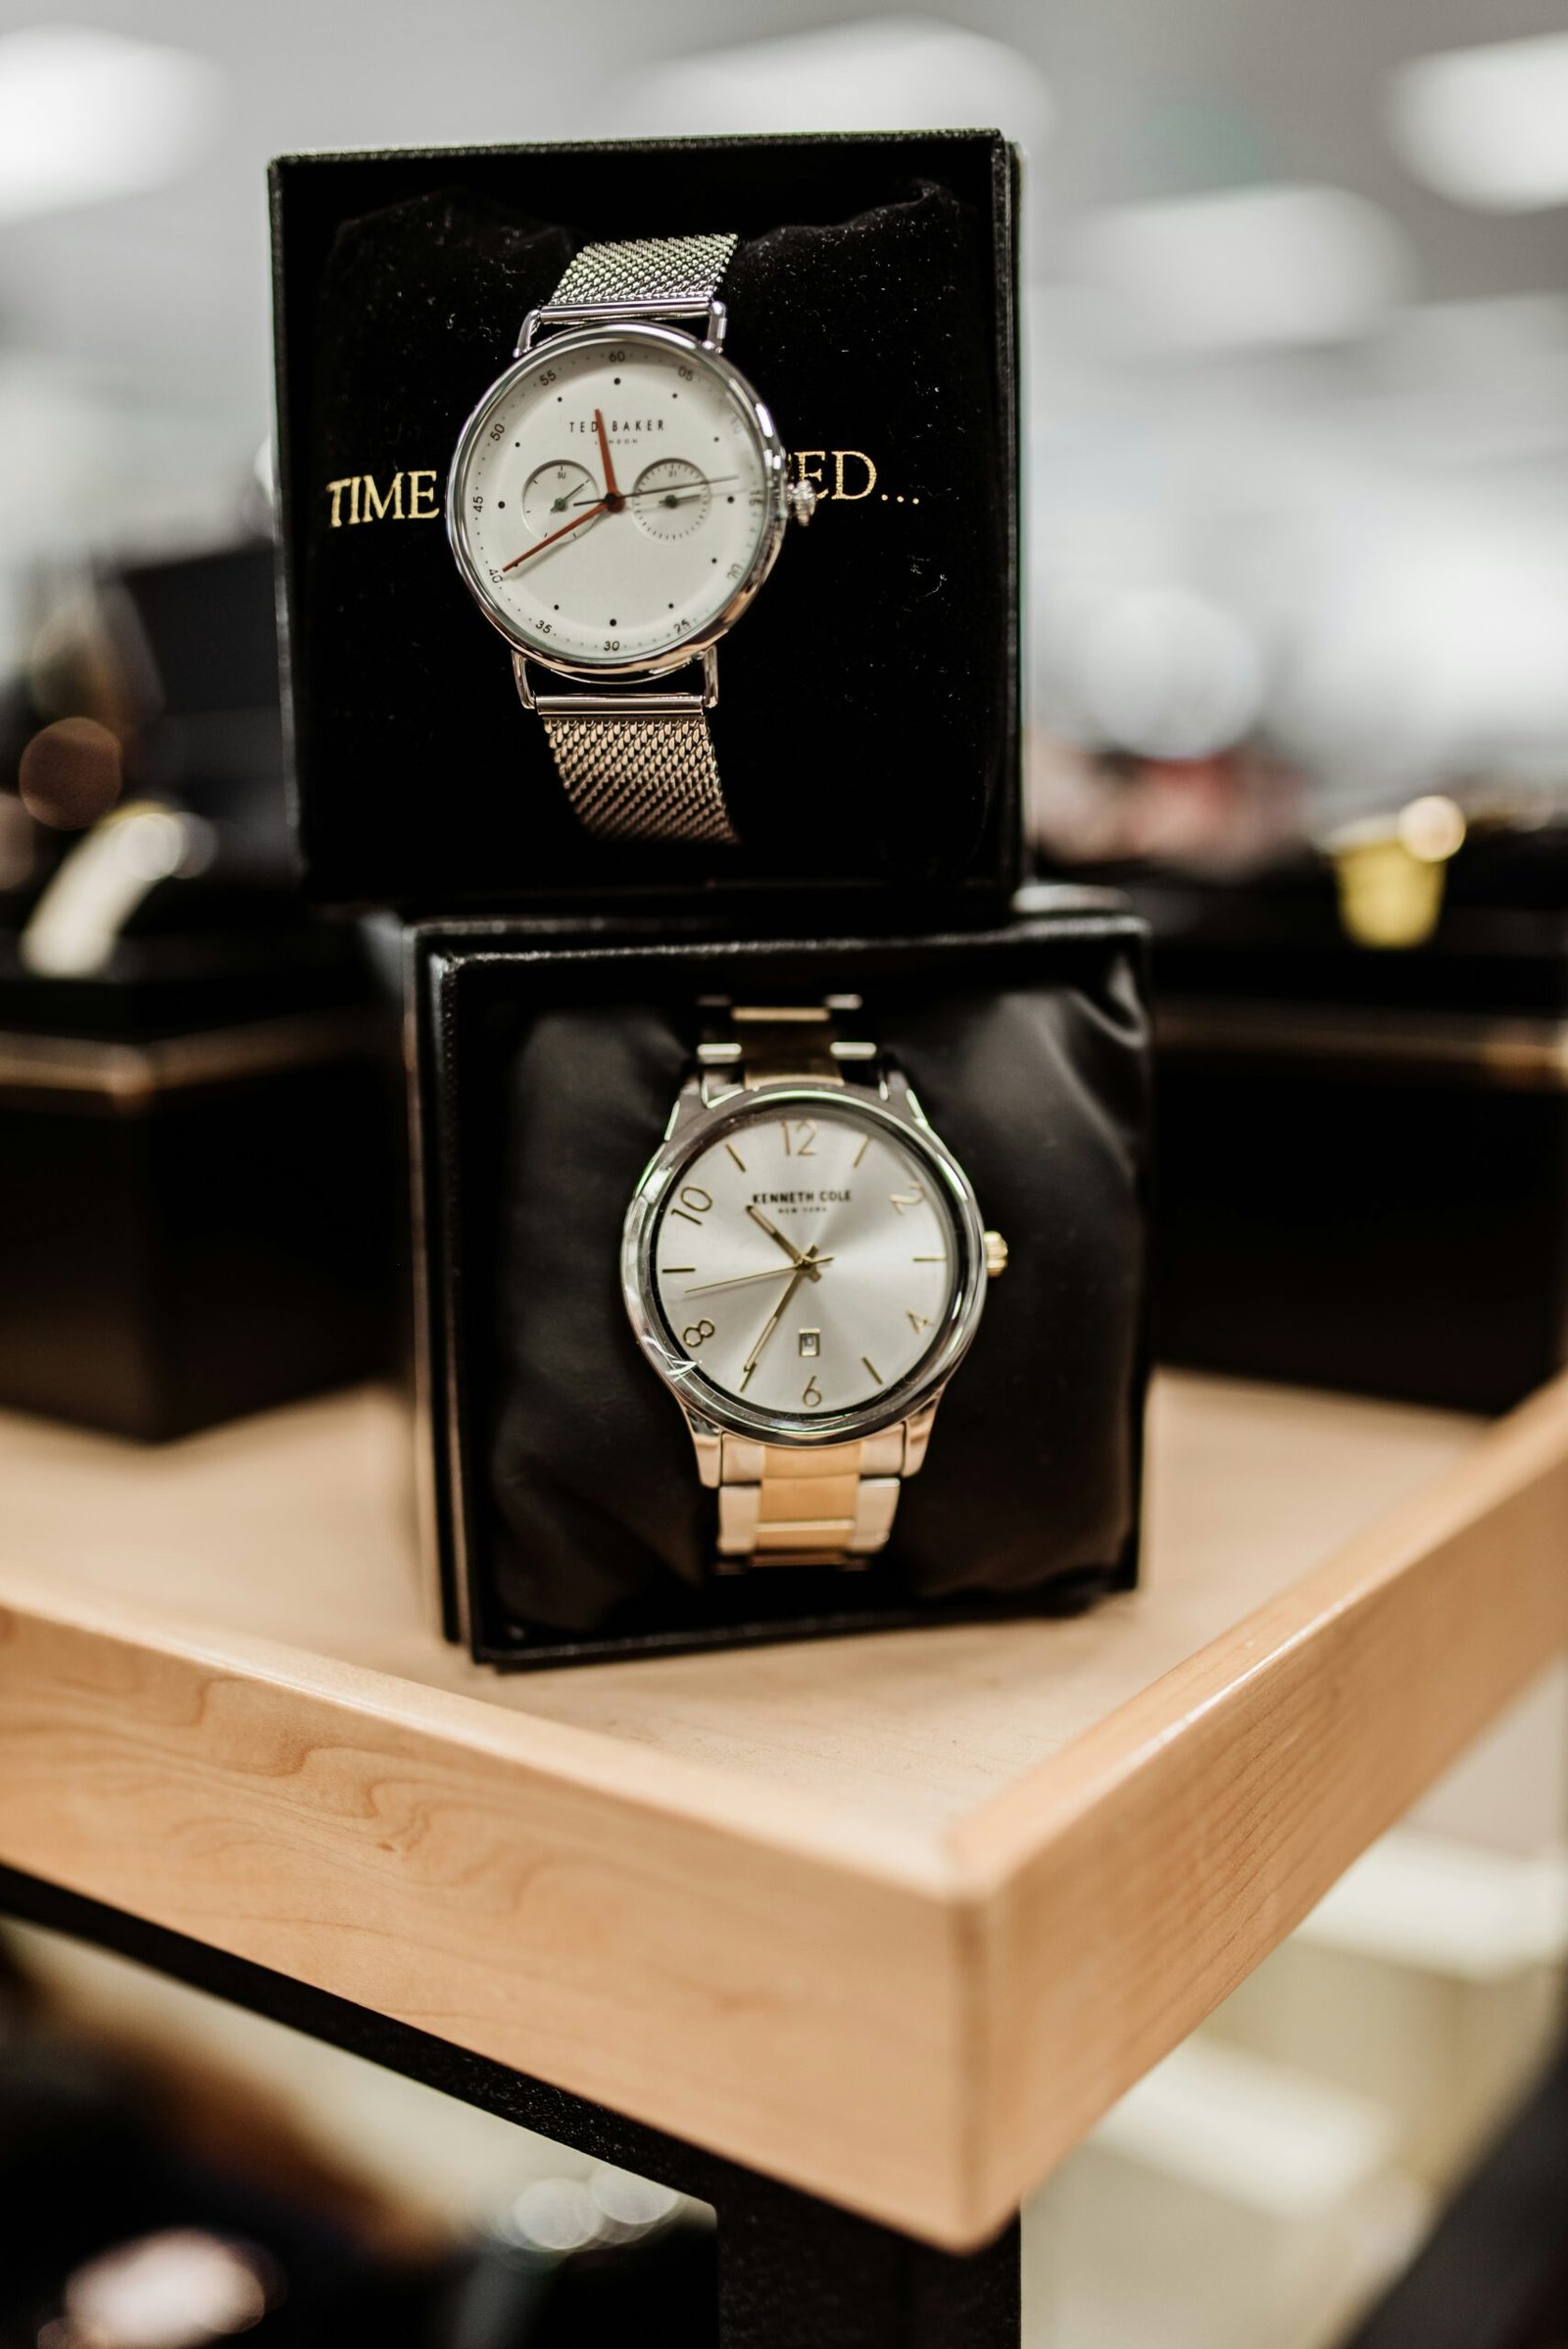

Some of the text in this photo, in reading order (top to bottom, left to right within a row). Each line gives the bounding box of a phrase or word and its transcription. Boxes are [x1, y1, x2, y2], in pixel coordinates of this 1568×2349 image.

[609, 351, 625, 363] 60
[540, 369, 557, 386] 55
[677, 366, 694, 382] 05
[490, 423, 505, 441] 50
[569, 419, 664, 433] TED BAKER
[326, 470, 440, 528] TIME
[472, 496, 484, 513] 45
[489, 568, 503, 583] 40
[535, 619, 553, 634] 35
[603, 640, 620, 652] 30
[780, 1119, 817, 1156] 12
[753, 1189, 851, 1204] KENNETH COLE
[890, 1180, 926, 1216] 2
[671, 1186, 712, 1225] 10
[683, 1319, 715, 1348] 8
[803, 1375, 822, 1408] 6
